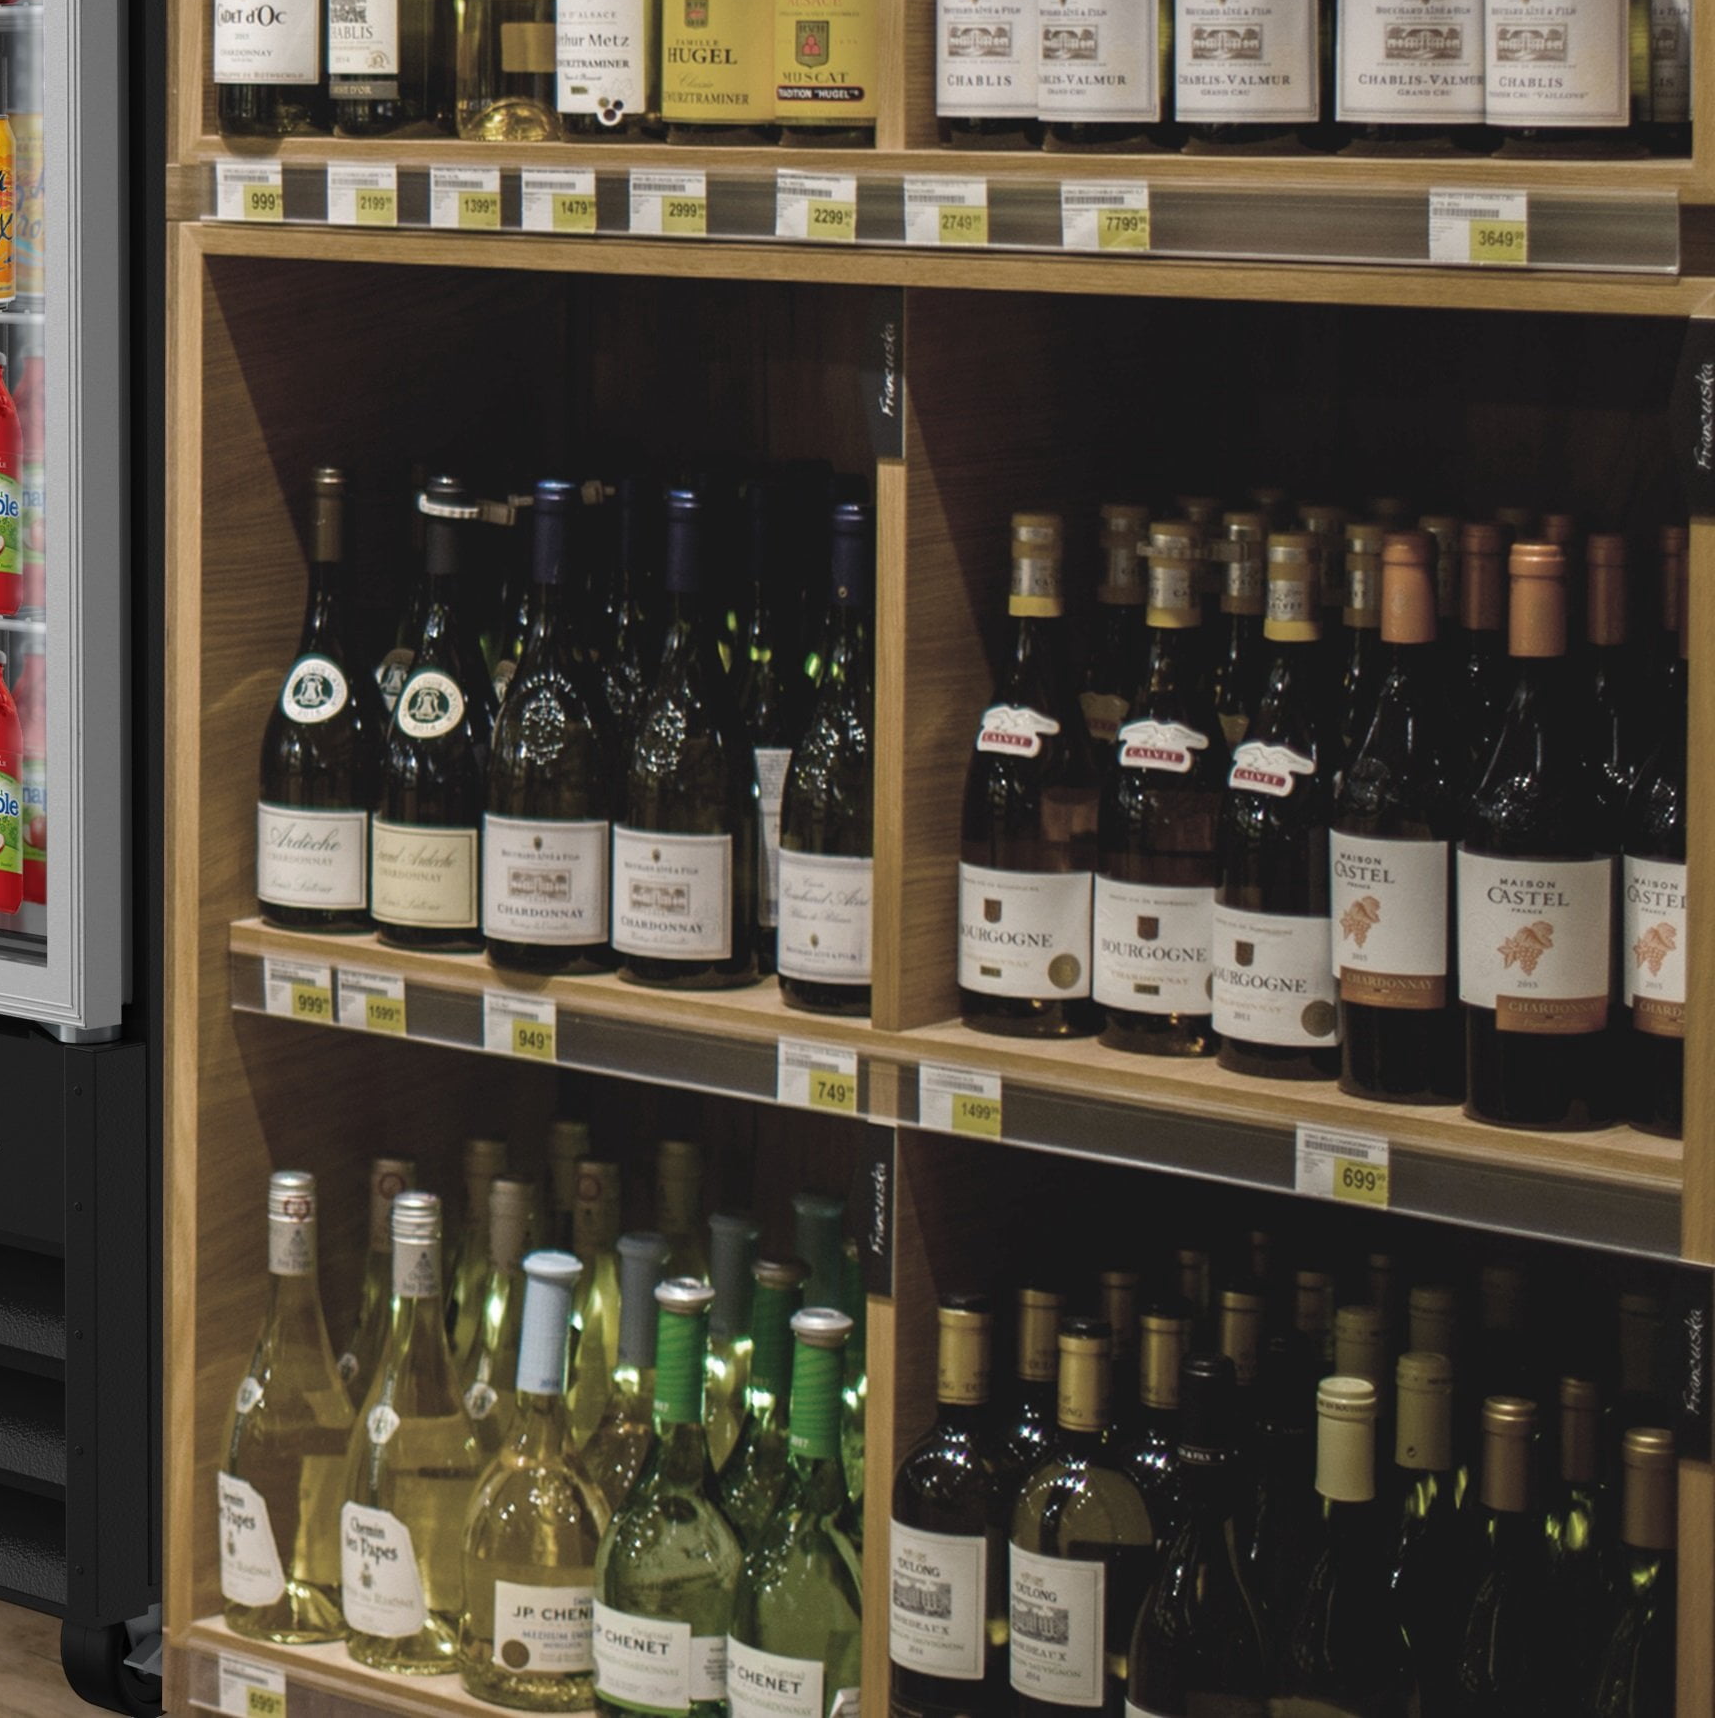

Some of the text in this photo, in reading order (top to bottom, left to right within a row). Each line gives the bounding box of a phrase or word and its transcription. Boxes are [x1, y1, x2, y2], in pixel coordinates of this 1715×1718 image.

[589, 33, 630, 48] Metz
[668, 47, 738, 67] HUGEL
[783, 72, 850, 84] MUSCAT
[947, 74, 1012, 88] CHABLIS
[1499, 76, 1563, 89] CHABLIS
[251, 192, 275, 210] 999
[360, 195, 386, 210] 2199
[464, 198, 490, 214] 1399
[561, 200, 588, 215] 1479
[669, 203, 697, 218] 2999
[814, 209, 844, 225] 2299
[941, 214, 972, 231] 2749
[1106, 216, 1138, 232] 7799
[1479, 230, 1514, 247] 3649
[879, 323, 896, 417] Francuska
[983, 734, 1026, 747] CALVET
[1129, 748, 1178, 762] CALVET
[1234, 769, 1281, 786] CALVET
[268, 825, 342, 854] Ardèche
[1340, 851, 1382, 866] MAISON
[1334, 859, 1396, 884] CASTEL
[1499, 877, 1556, 889] MAISON
[1633, 876, 1679, 890] MAISON
[1486, 885, 1570, 908] CASTEL
[497, 903, 585, 920] CHARDONNAY
[621, 916, 705, 935] CHARDONNAY
[1101, 938, 1207, 963] BOURGOGNE
[298, 995, 324, 1013] 999
[519, 1029, 545, 1051] 949
[817, 1081, 846, 1103] 749
[962, 1102, 991, 1121] 1499
[1342, 1167, 1377, 1193] 699
[1684, 1308, 1703, 1415] Francuska
[360, 1539, 399, 1564] Papes
[605, 1629, 670, 1656] CHENET
[738, 1666, 802, 1695] CHENET
